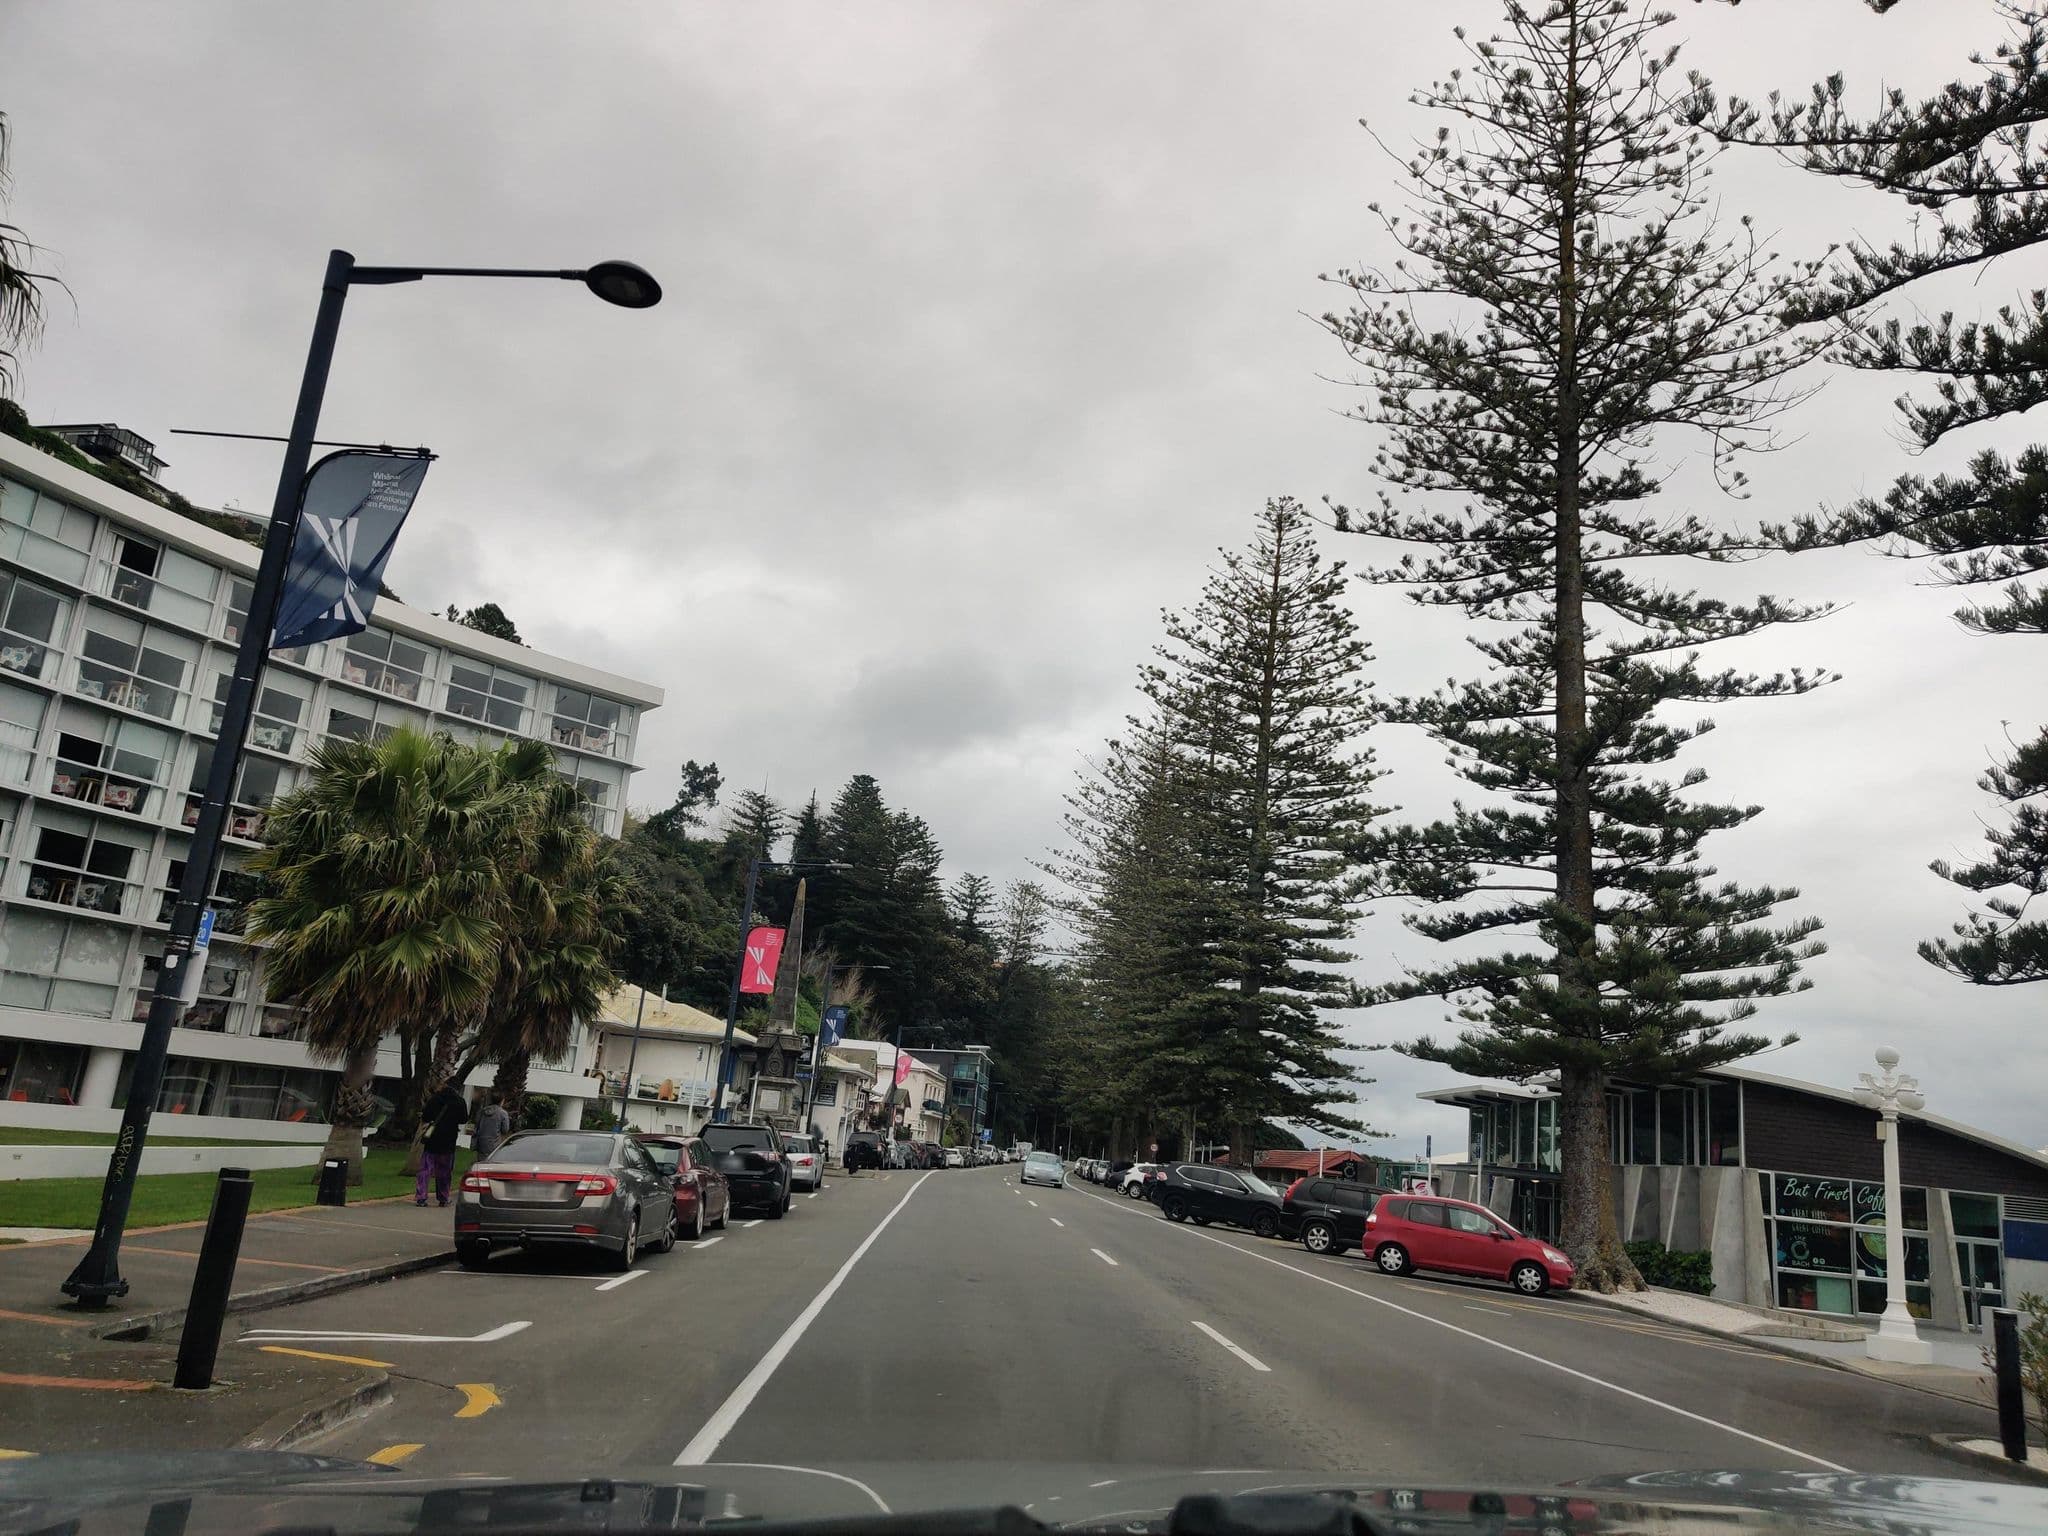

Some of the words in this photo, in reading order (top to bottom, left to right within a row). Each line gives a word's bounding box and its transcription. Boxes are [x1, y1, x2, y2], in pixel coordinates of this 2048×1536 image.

[1783, 1178, 1810, 1197] But
[1814, 1181, 1849, 1200] First
[1857, 1186, 1886, 1211] Coff
